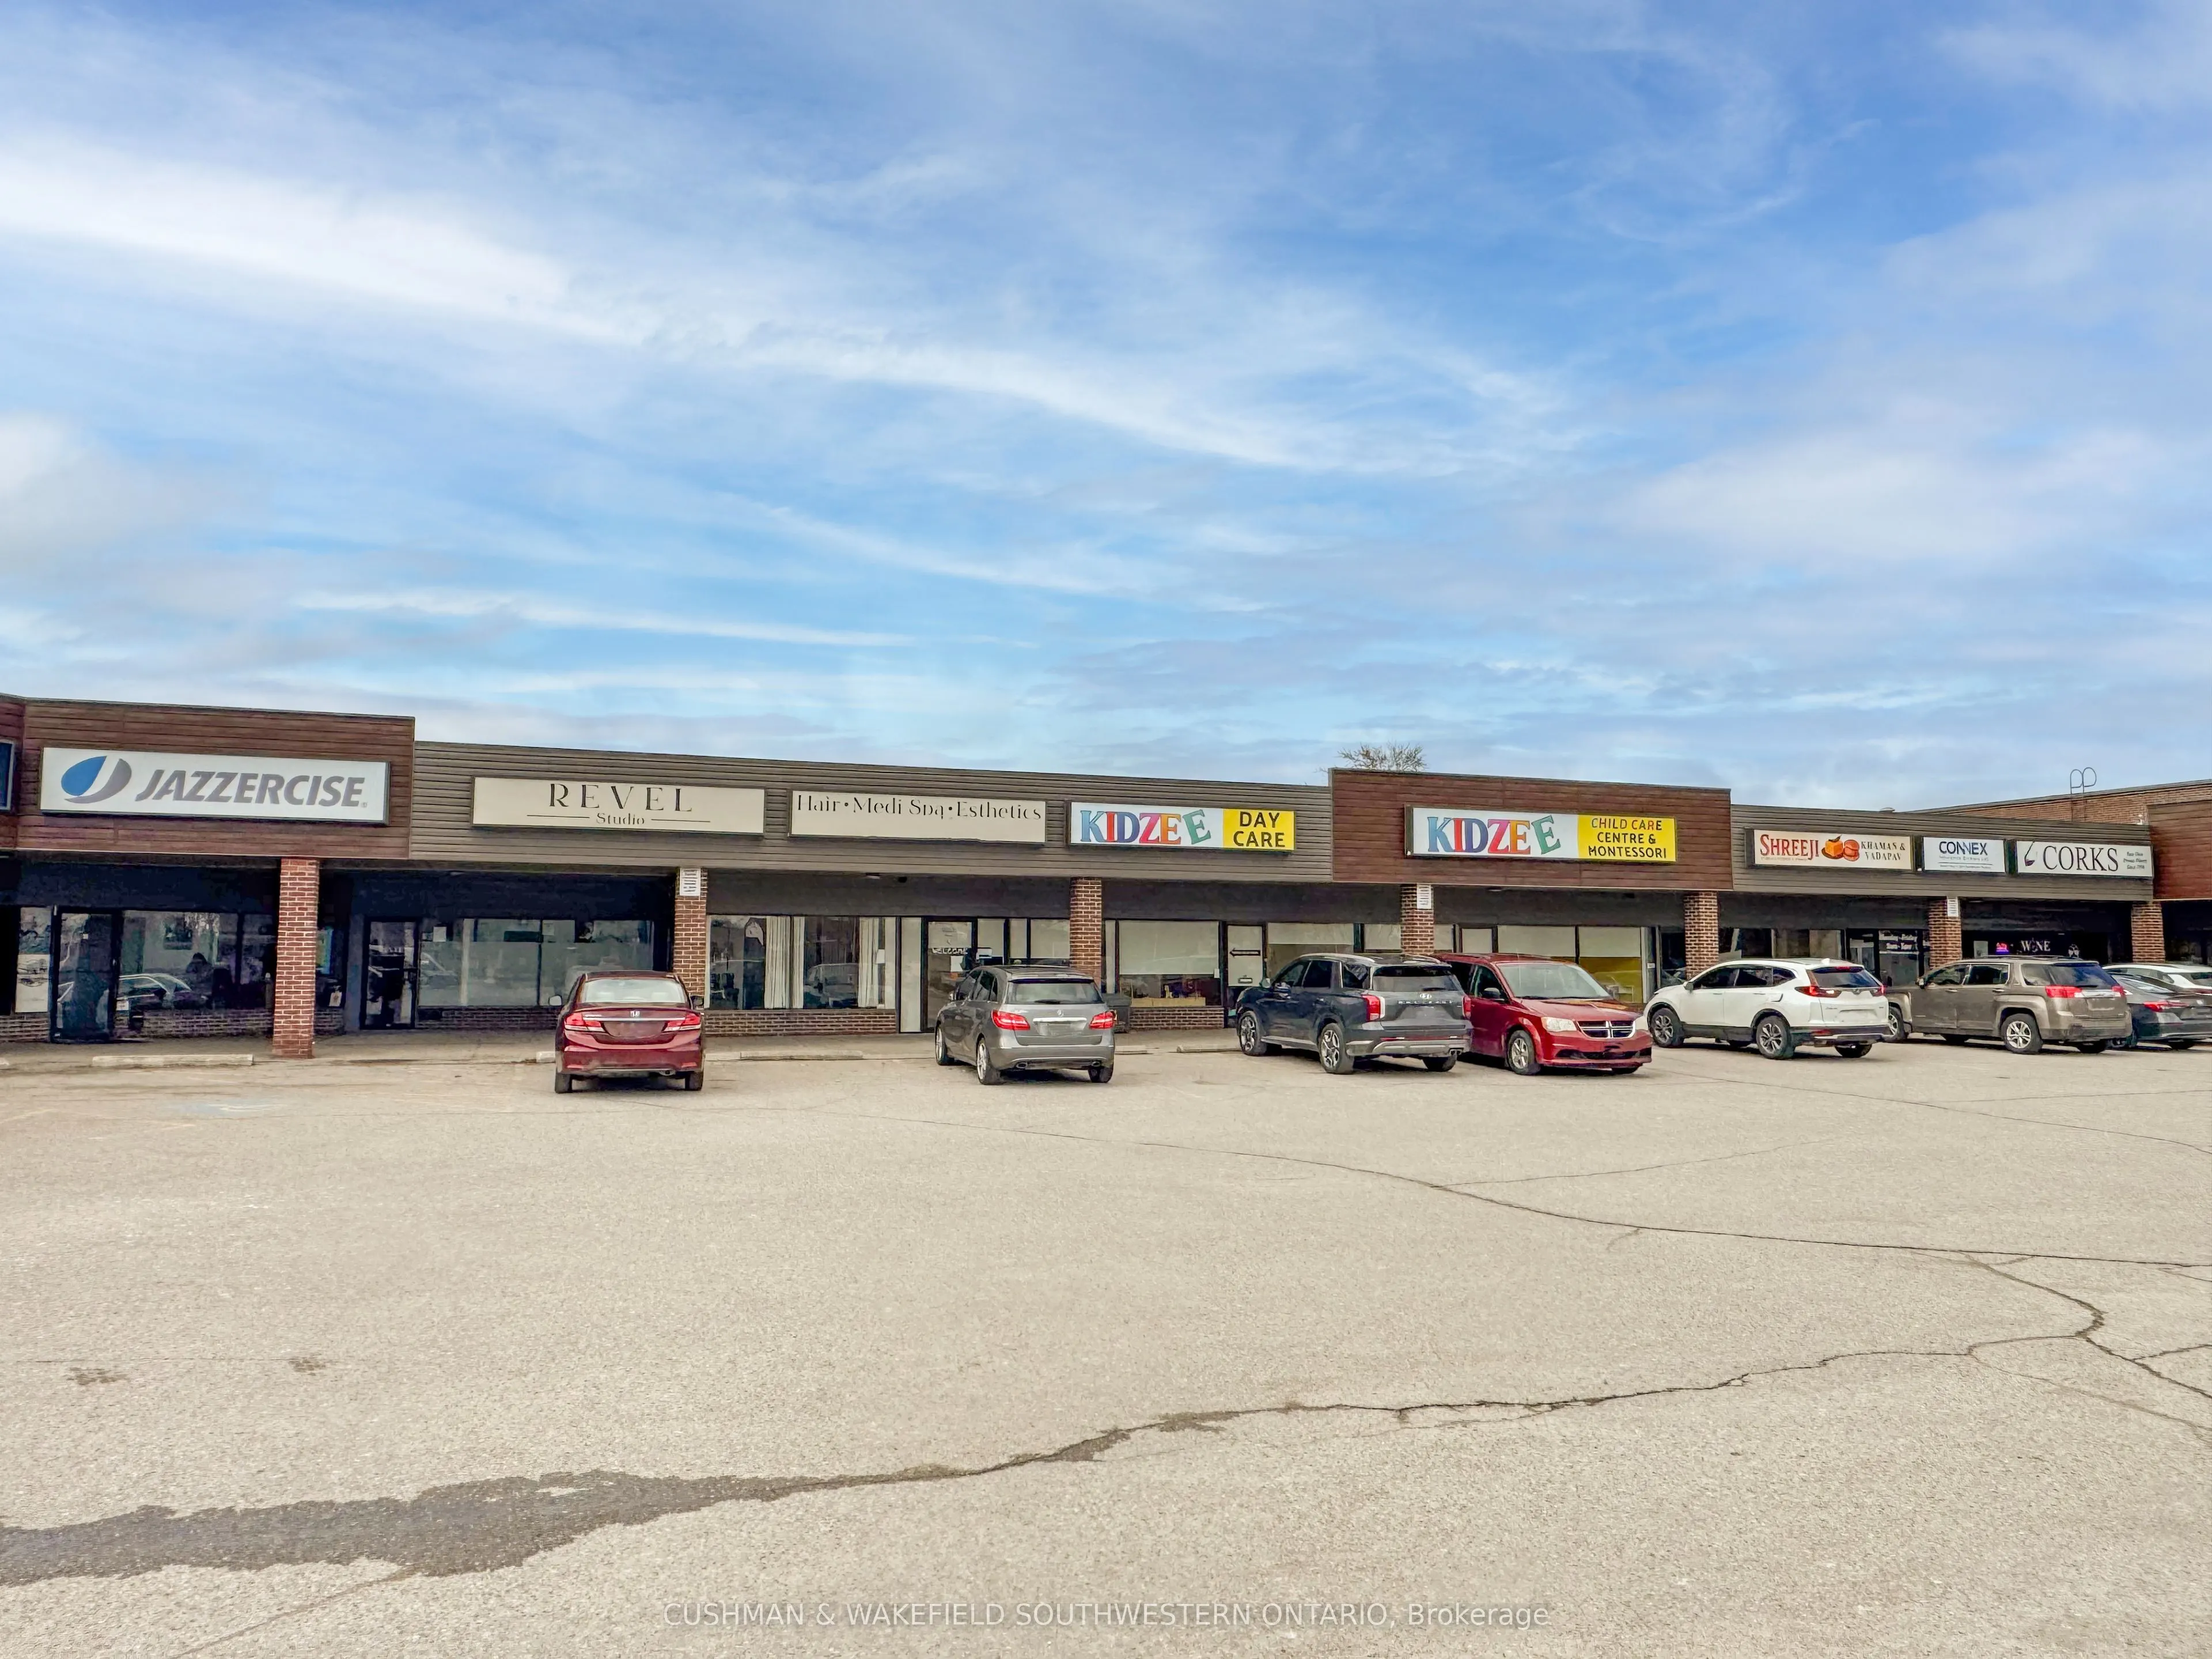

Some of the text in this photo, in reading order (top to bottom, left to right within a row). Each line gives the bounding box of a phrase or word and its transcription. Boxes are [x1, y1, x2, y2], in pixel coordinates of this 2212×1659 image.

[135, 770, 365, 807] JAZZERCISE
[550, 783, 692, 812] REVEL
[596, 813, 645, 825] Studio
[1080, 809, 1211, 845] KIDZEE
[1240, 811, 1280, 828] DAY
[1592, 818, 1662, 831] CHILD CARE
[1233, 831, 1285, 847] CARE
[1427, 815, 1561, 855] KIDZEE
[1597, 832, 1656, 844] CENTRE &
[1588, 846, 1666, 859] MONTESSORI
[1760, 834, 1819, 860] SHREEJI
[1900, 843, 1906, 851] &
[1939, 841, 1988, 855] CONNEX
[2043, 846, 2118, 872] CORKS
